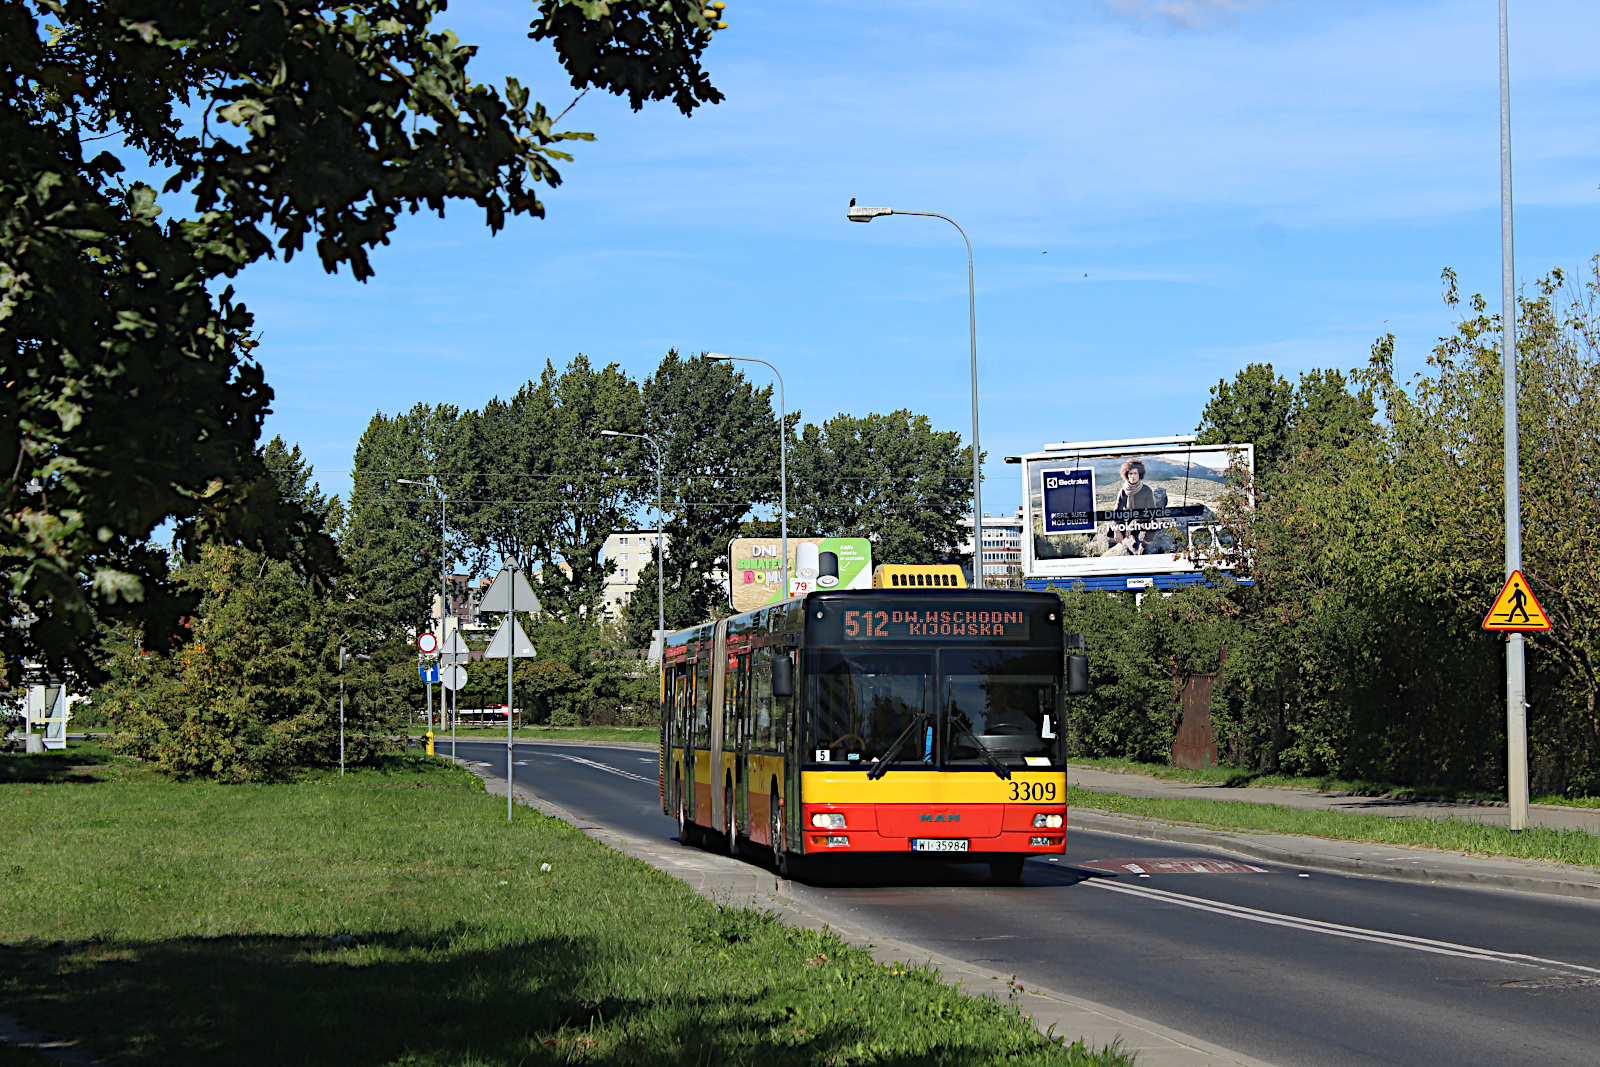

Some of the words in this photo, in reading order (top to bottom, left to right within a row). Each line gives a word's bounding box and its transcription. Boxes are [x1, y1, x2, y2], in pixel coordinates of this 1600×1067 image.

[1058, 478, 1089, 486] Electrolux
[1104, 508, 1140, 521] Długie
[1143, 507, 1172, 521] życie
[1105, 521, 1141, 532] Twoich
[752, 544, 777, 558] DNI
[845, 611, 889, 637] 512
[909, 623, 1004, 636] KIJOWSKA
[819, 750, 826, 761] 5
[1008, 781, 1056, 801] 3309
[919, 813, 961, 822] MAN
[919, 840, 930, 850] WI
[935, 840, 967, 851] 35984
